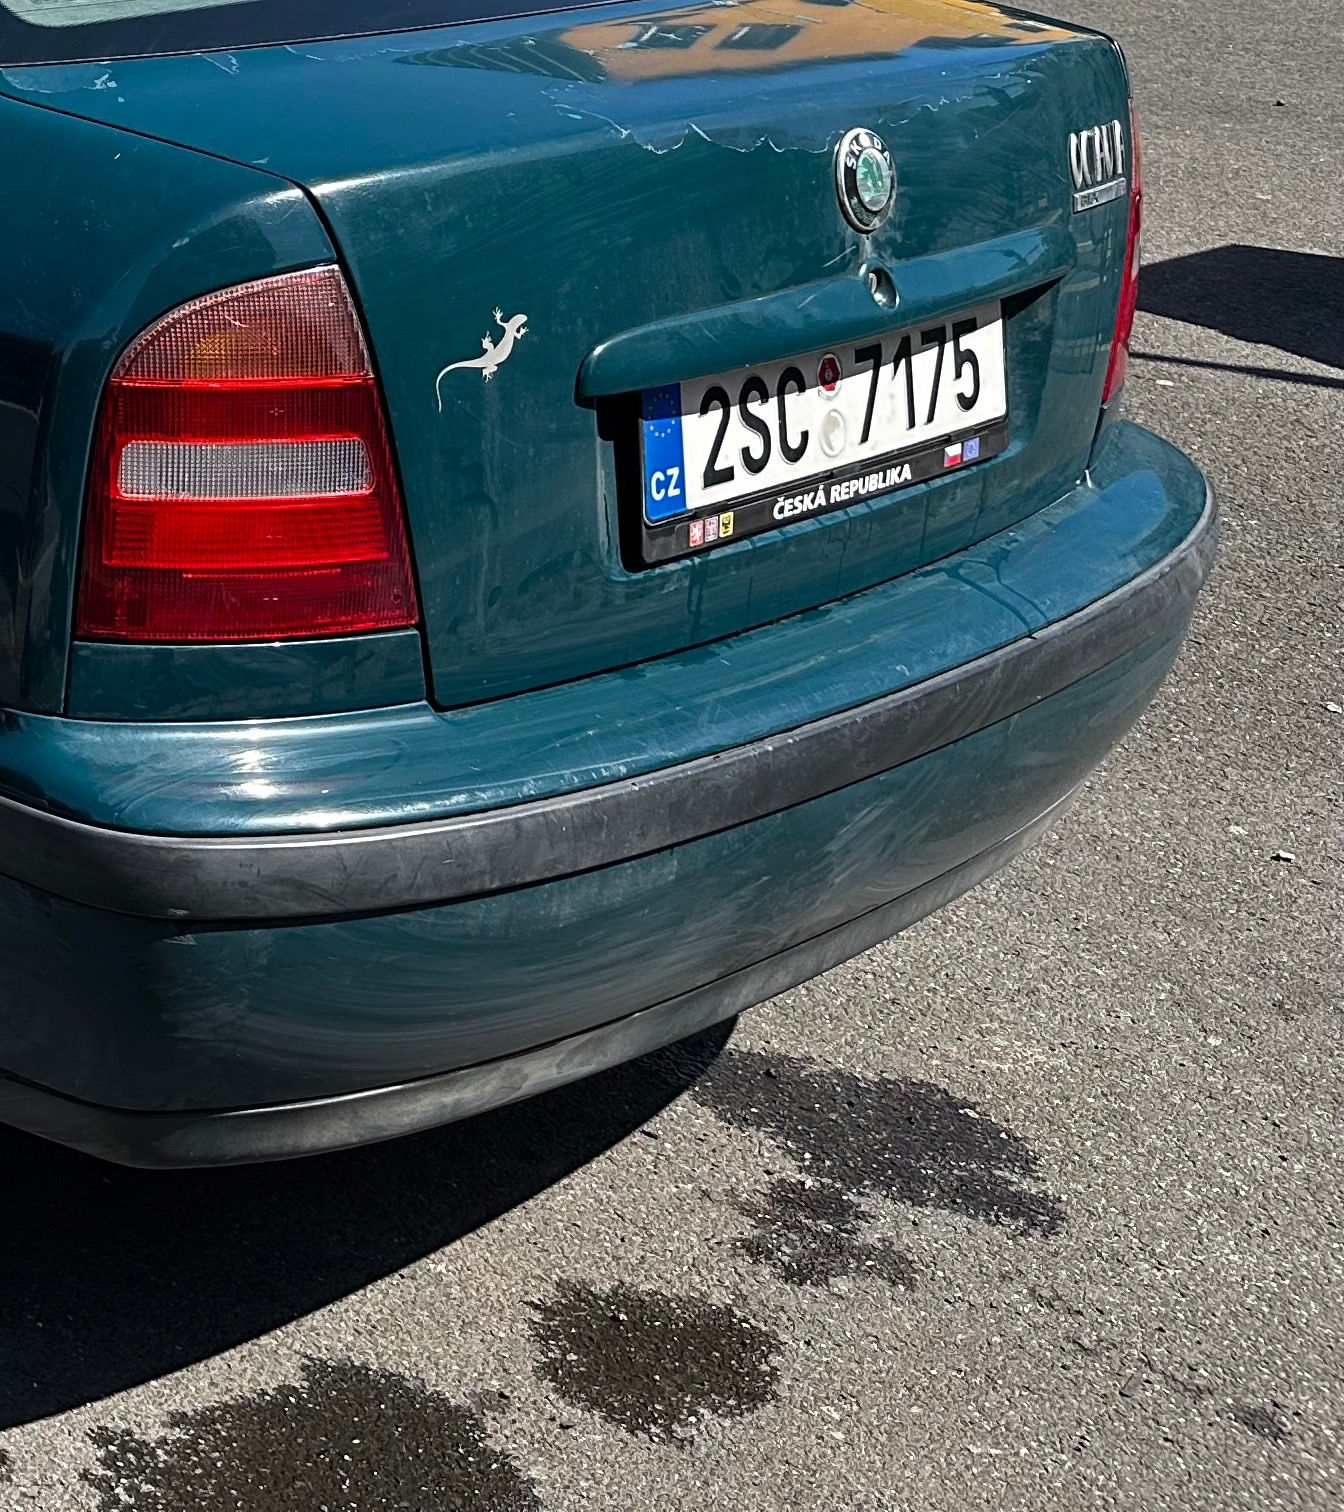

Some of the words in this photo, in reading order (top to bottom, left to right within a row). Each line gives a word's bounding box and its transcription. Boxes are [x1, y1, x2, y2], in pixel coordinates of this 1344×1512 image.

[698, 366, 809, 490] 2SC
[855, 316, 981, 445] 7175
[650, 466, 681, 502] CZ
[773, 484, 826, 520] ČESKÁ
[830, 463, 912, 504] REPUBLIKA
